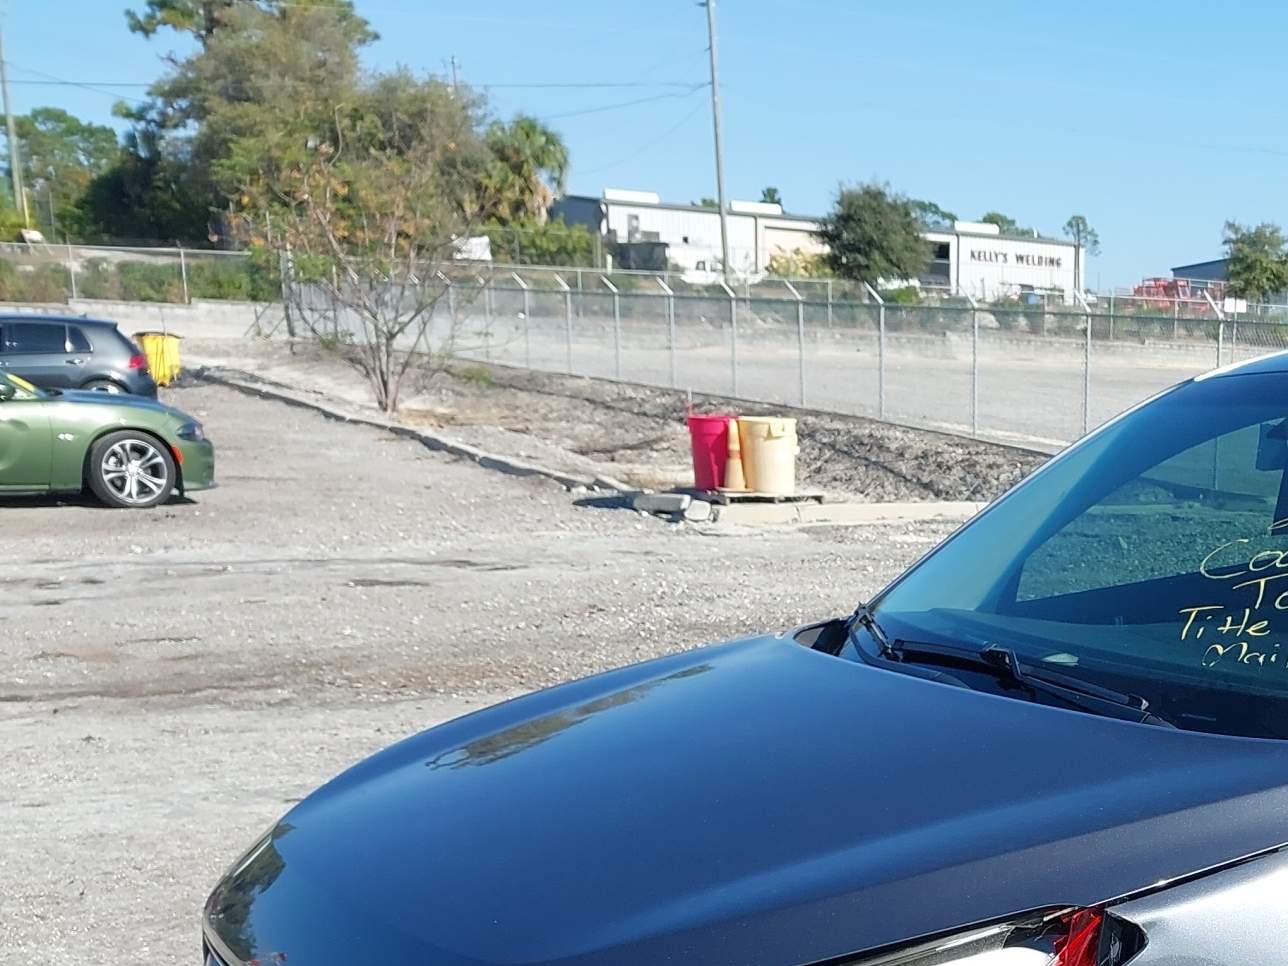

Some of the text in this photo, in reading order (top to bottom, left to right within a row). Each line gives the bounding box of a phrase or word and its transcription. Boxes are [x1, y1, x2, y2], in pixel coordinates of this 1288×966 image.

[970, 249, 1063, 268] KELLY'S WELDING
[1178, 605, 1272, 641] Title
